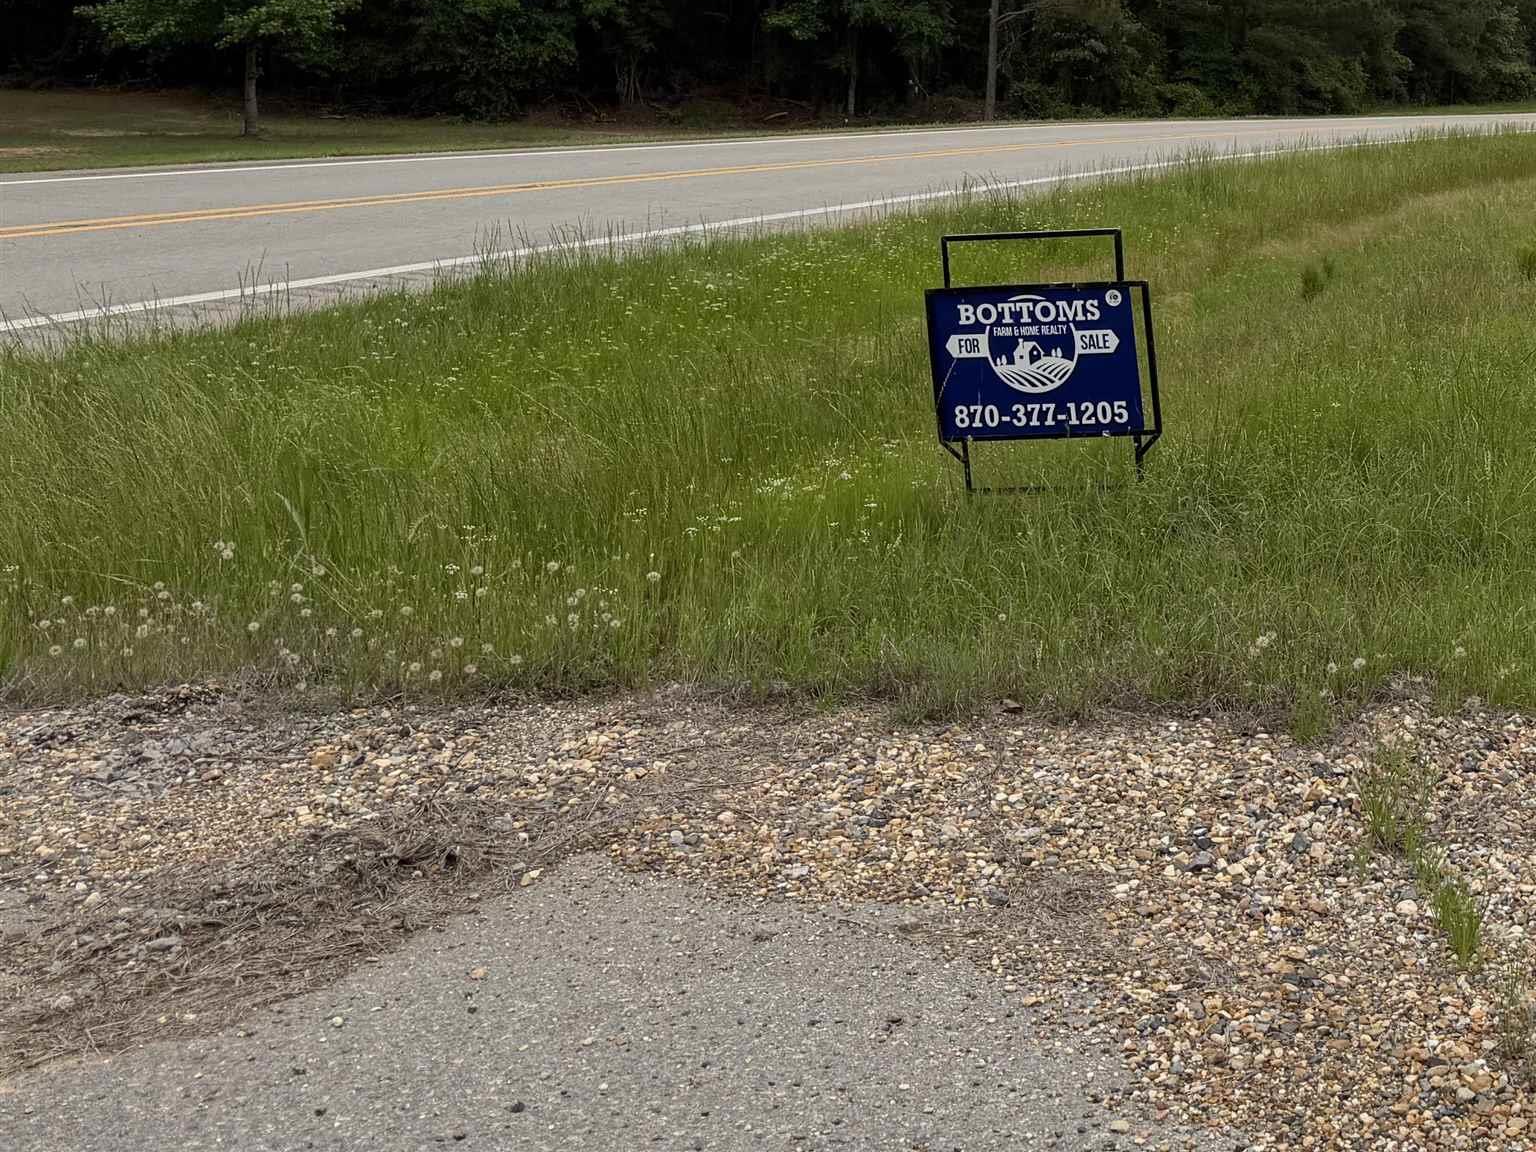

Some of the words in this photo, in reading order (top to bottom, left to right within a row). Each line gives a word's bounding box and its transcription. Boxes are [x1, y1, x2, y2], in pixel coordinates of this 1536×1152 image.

[957, 299, 1101, 325] BOTTOMS
[993, 327, 1012, 337] FARM
[1020, 326, 1040, 336] HOME
[1042, 325, 1068, 335] REALTY
[958, 338, 980, 354] FOR
[1080, 334, 1110, 350] SALE
[954, 401, 1129, 428] 870-377-1205
